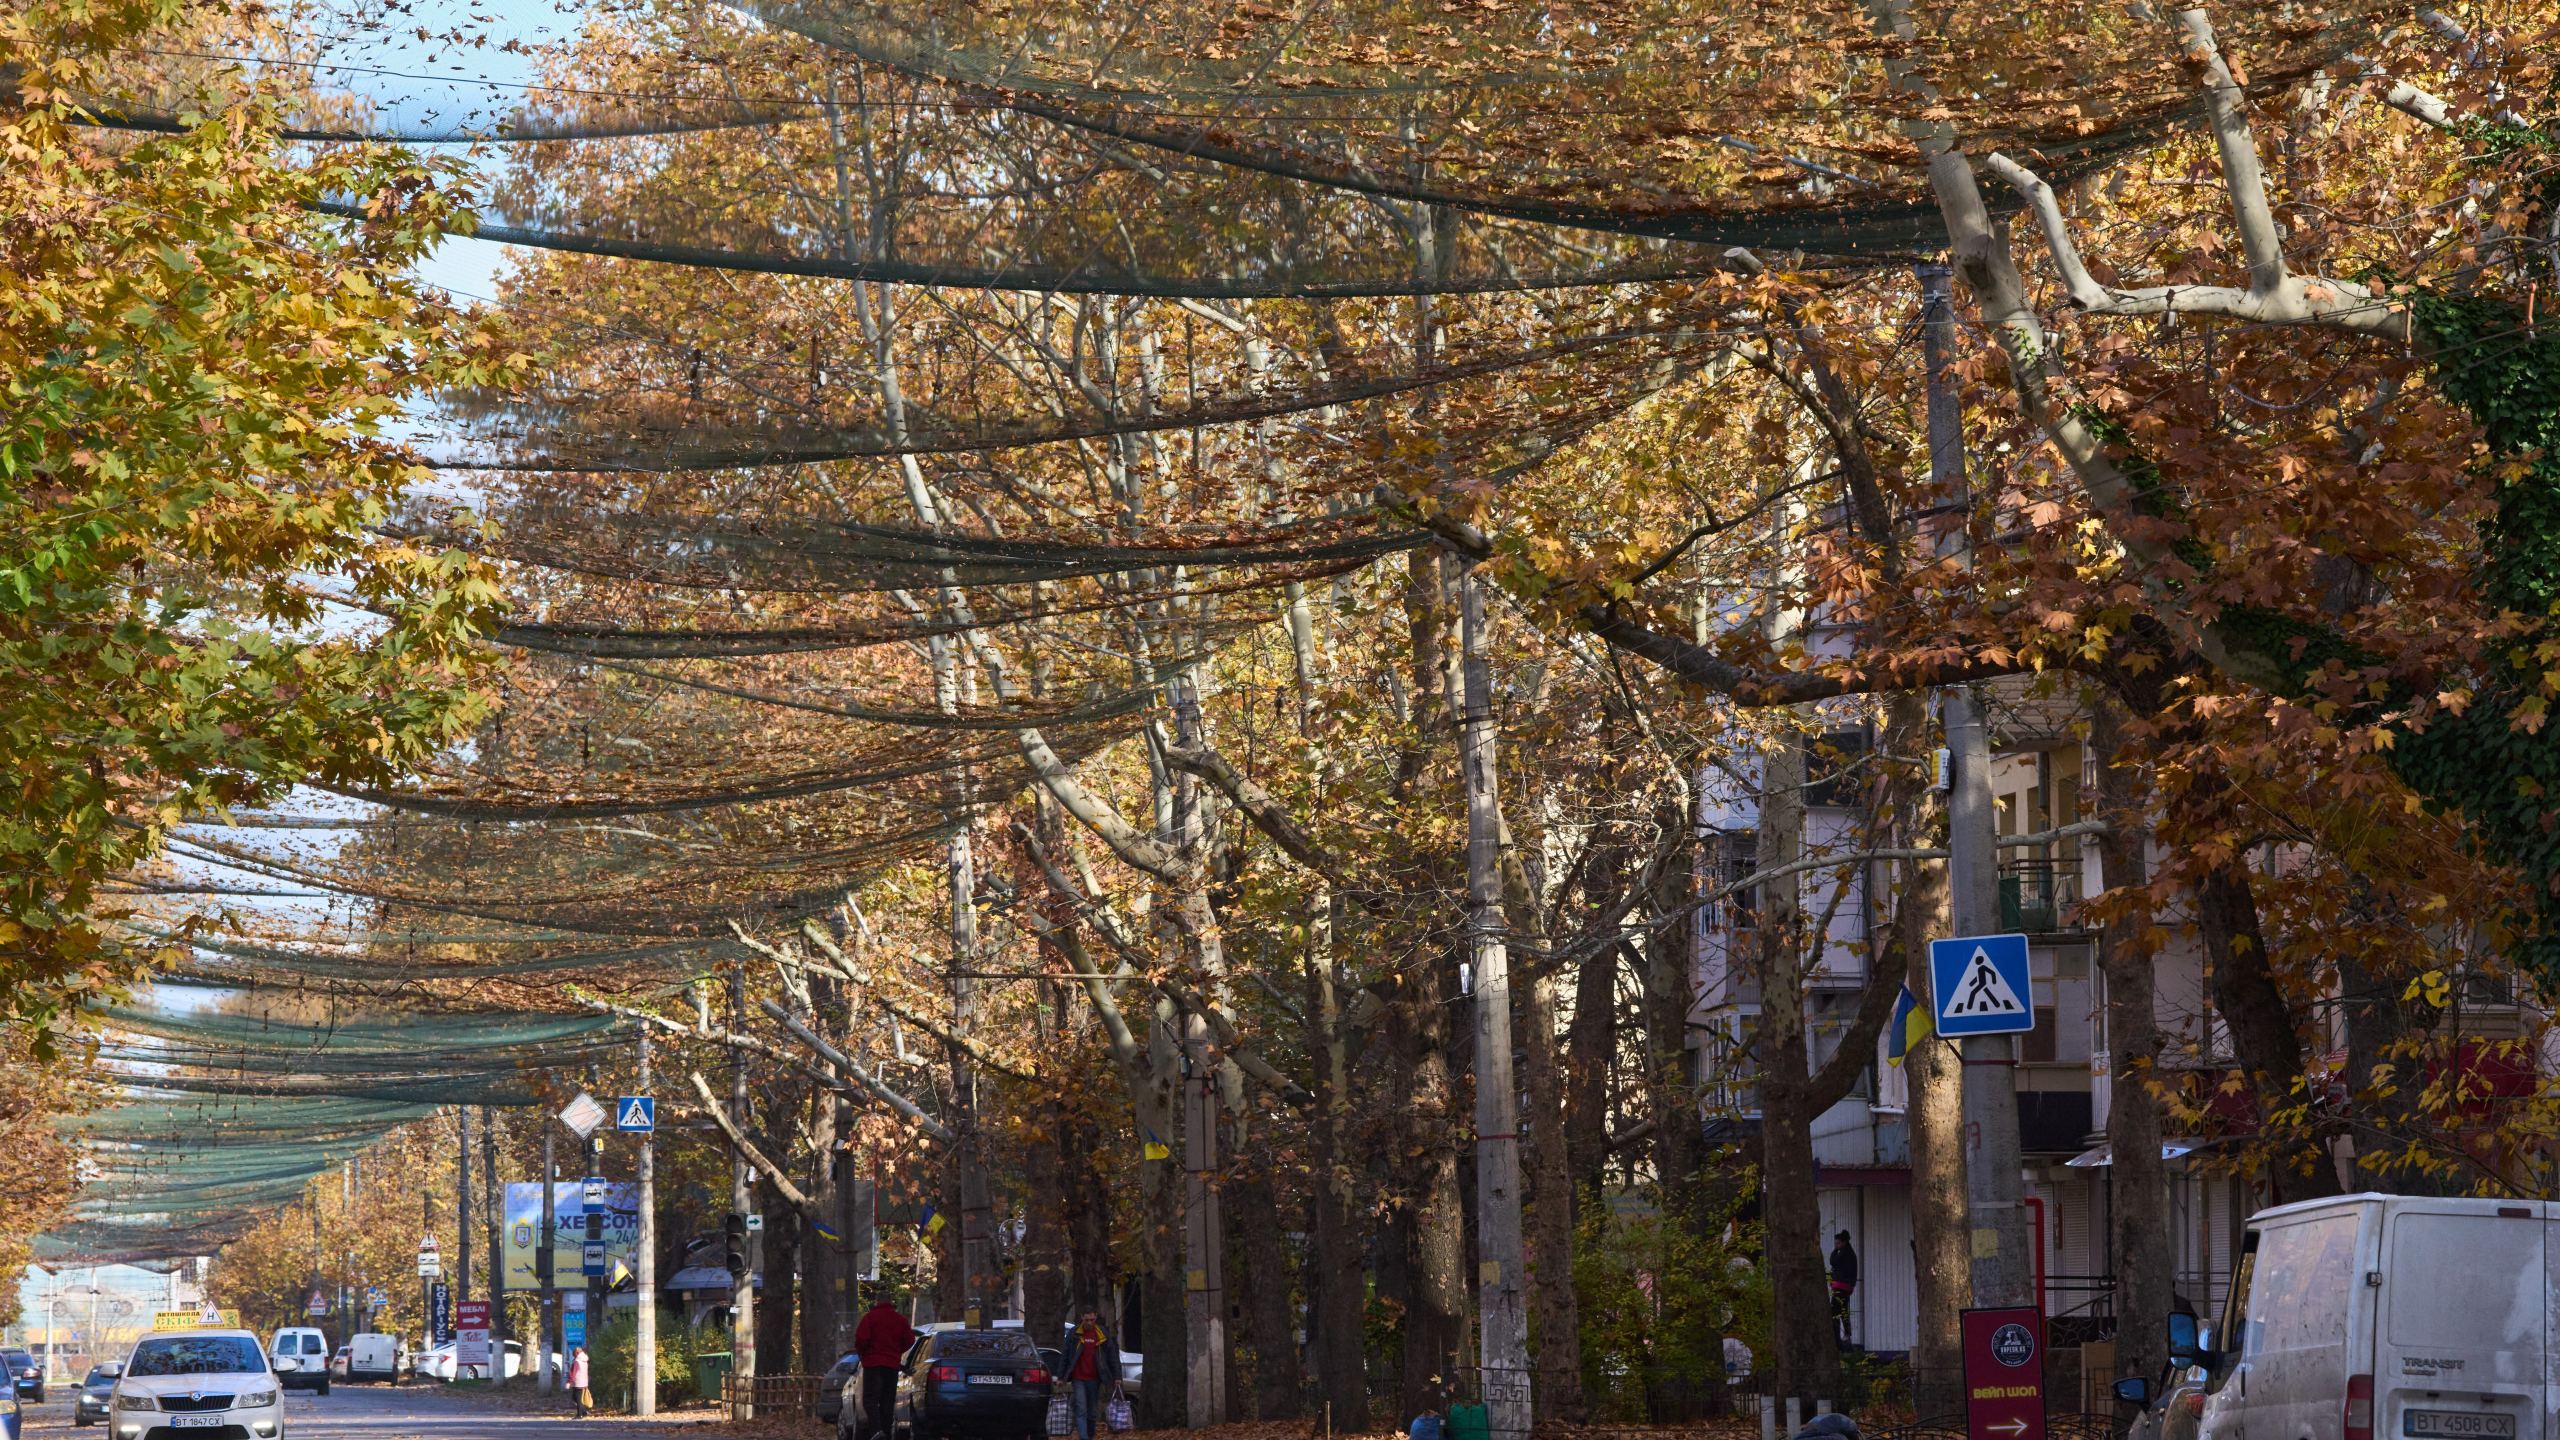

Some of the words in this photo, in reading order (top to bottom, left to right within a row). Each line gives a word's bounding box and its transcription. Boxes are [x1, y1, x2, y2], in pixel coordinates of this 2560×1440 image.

[559, 1215, 639, 1230] ХЕСОН
[615, 1230, 639, 1245] 24/
[460, 1305, 486, 1313] МЕБЛІ
[207, 1312, 214, 1321] Н
[2402, 1357, 2465, 1370] TRANSIT
[2006, 1386, 2037, 1398] ШОП
[176, 1418, 187, 1427] BT
[208, 1417, 220, 1425] CX
[2417, 1415, 2440, 1431] BT
[2444, 1416, 2481, 1433] 4508
[2485, 1418, 2509, 1434] CX
